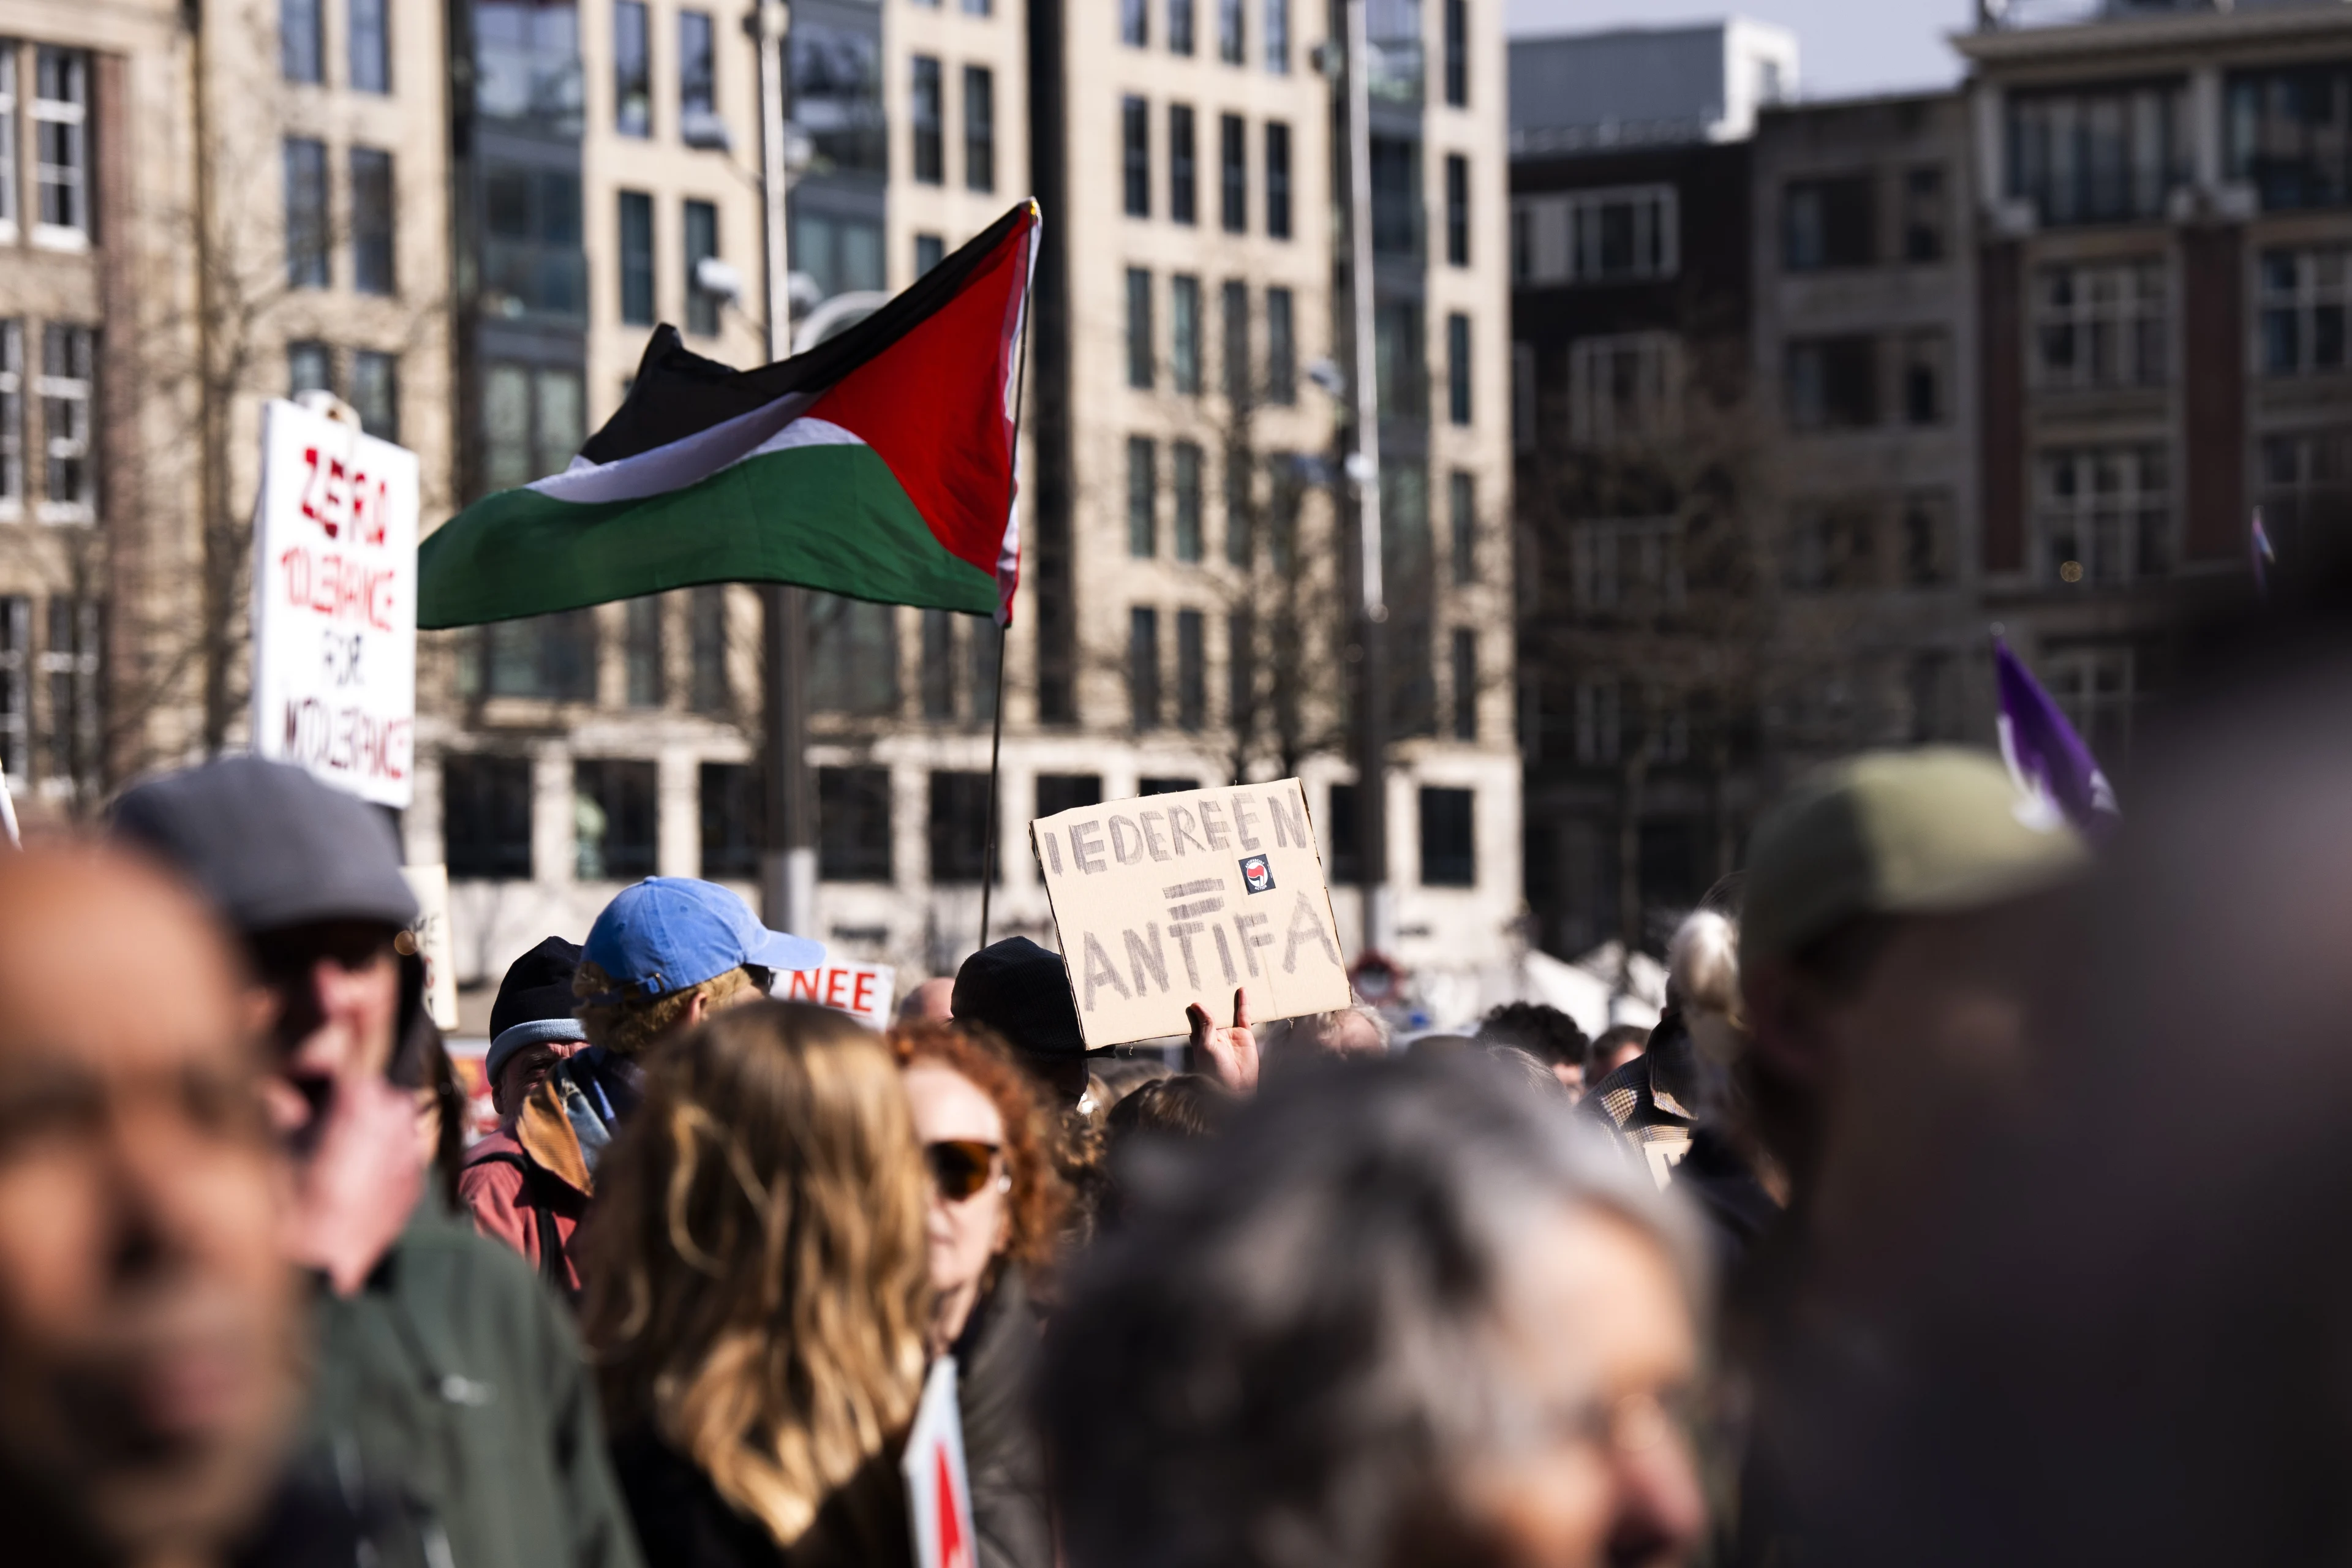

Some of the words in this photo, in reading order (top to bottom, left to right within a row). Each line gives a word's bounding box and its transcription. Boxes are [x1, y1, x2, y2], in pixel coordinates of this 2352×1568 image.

[301, 446, 386, 545] ZERO
[1044, 788, 1307, 876] IEDEREEN
[1245, 858, 1265, 869] ANTIFASCIST
[789, 967, 875, 1012] NEE
[1084, 890, 1340, 1012] ANTIFA
